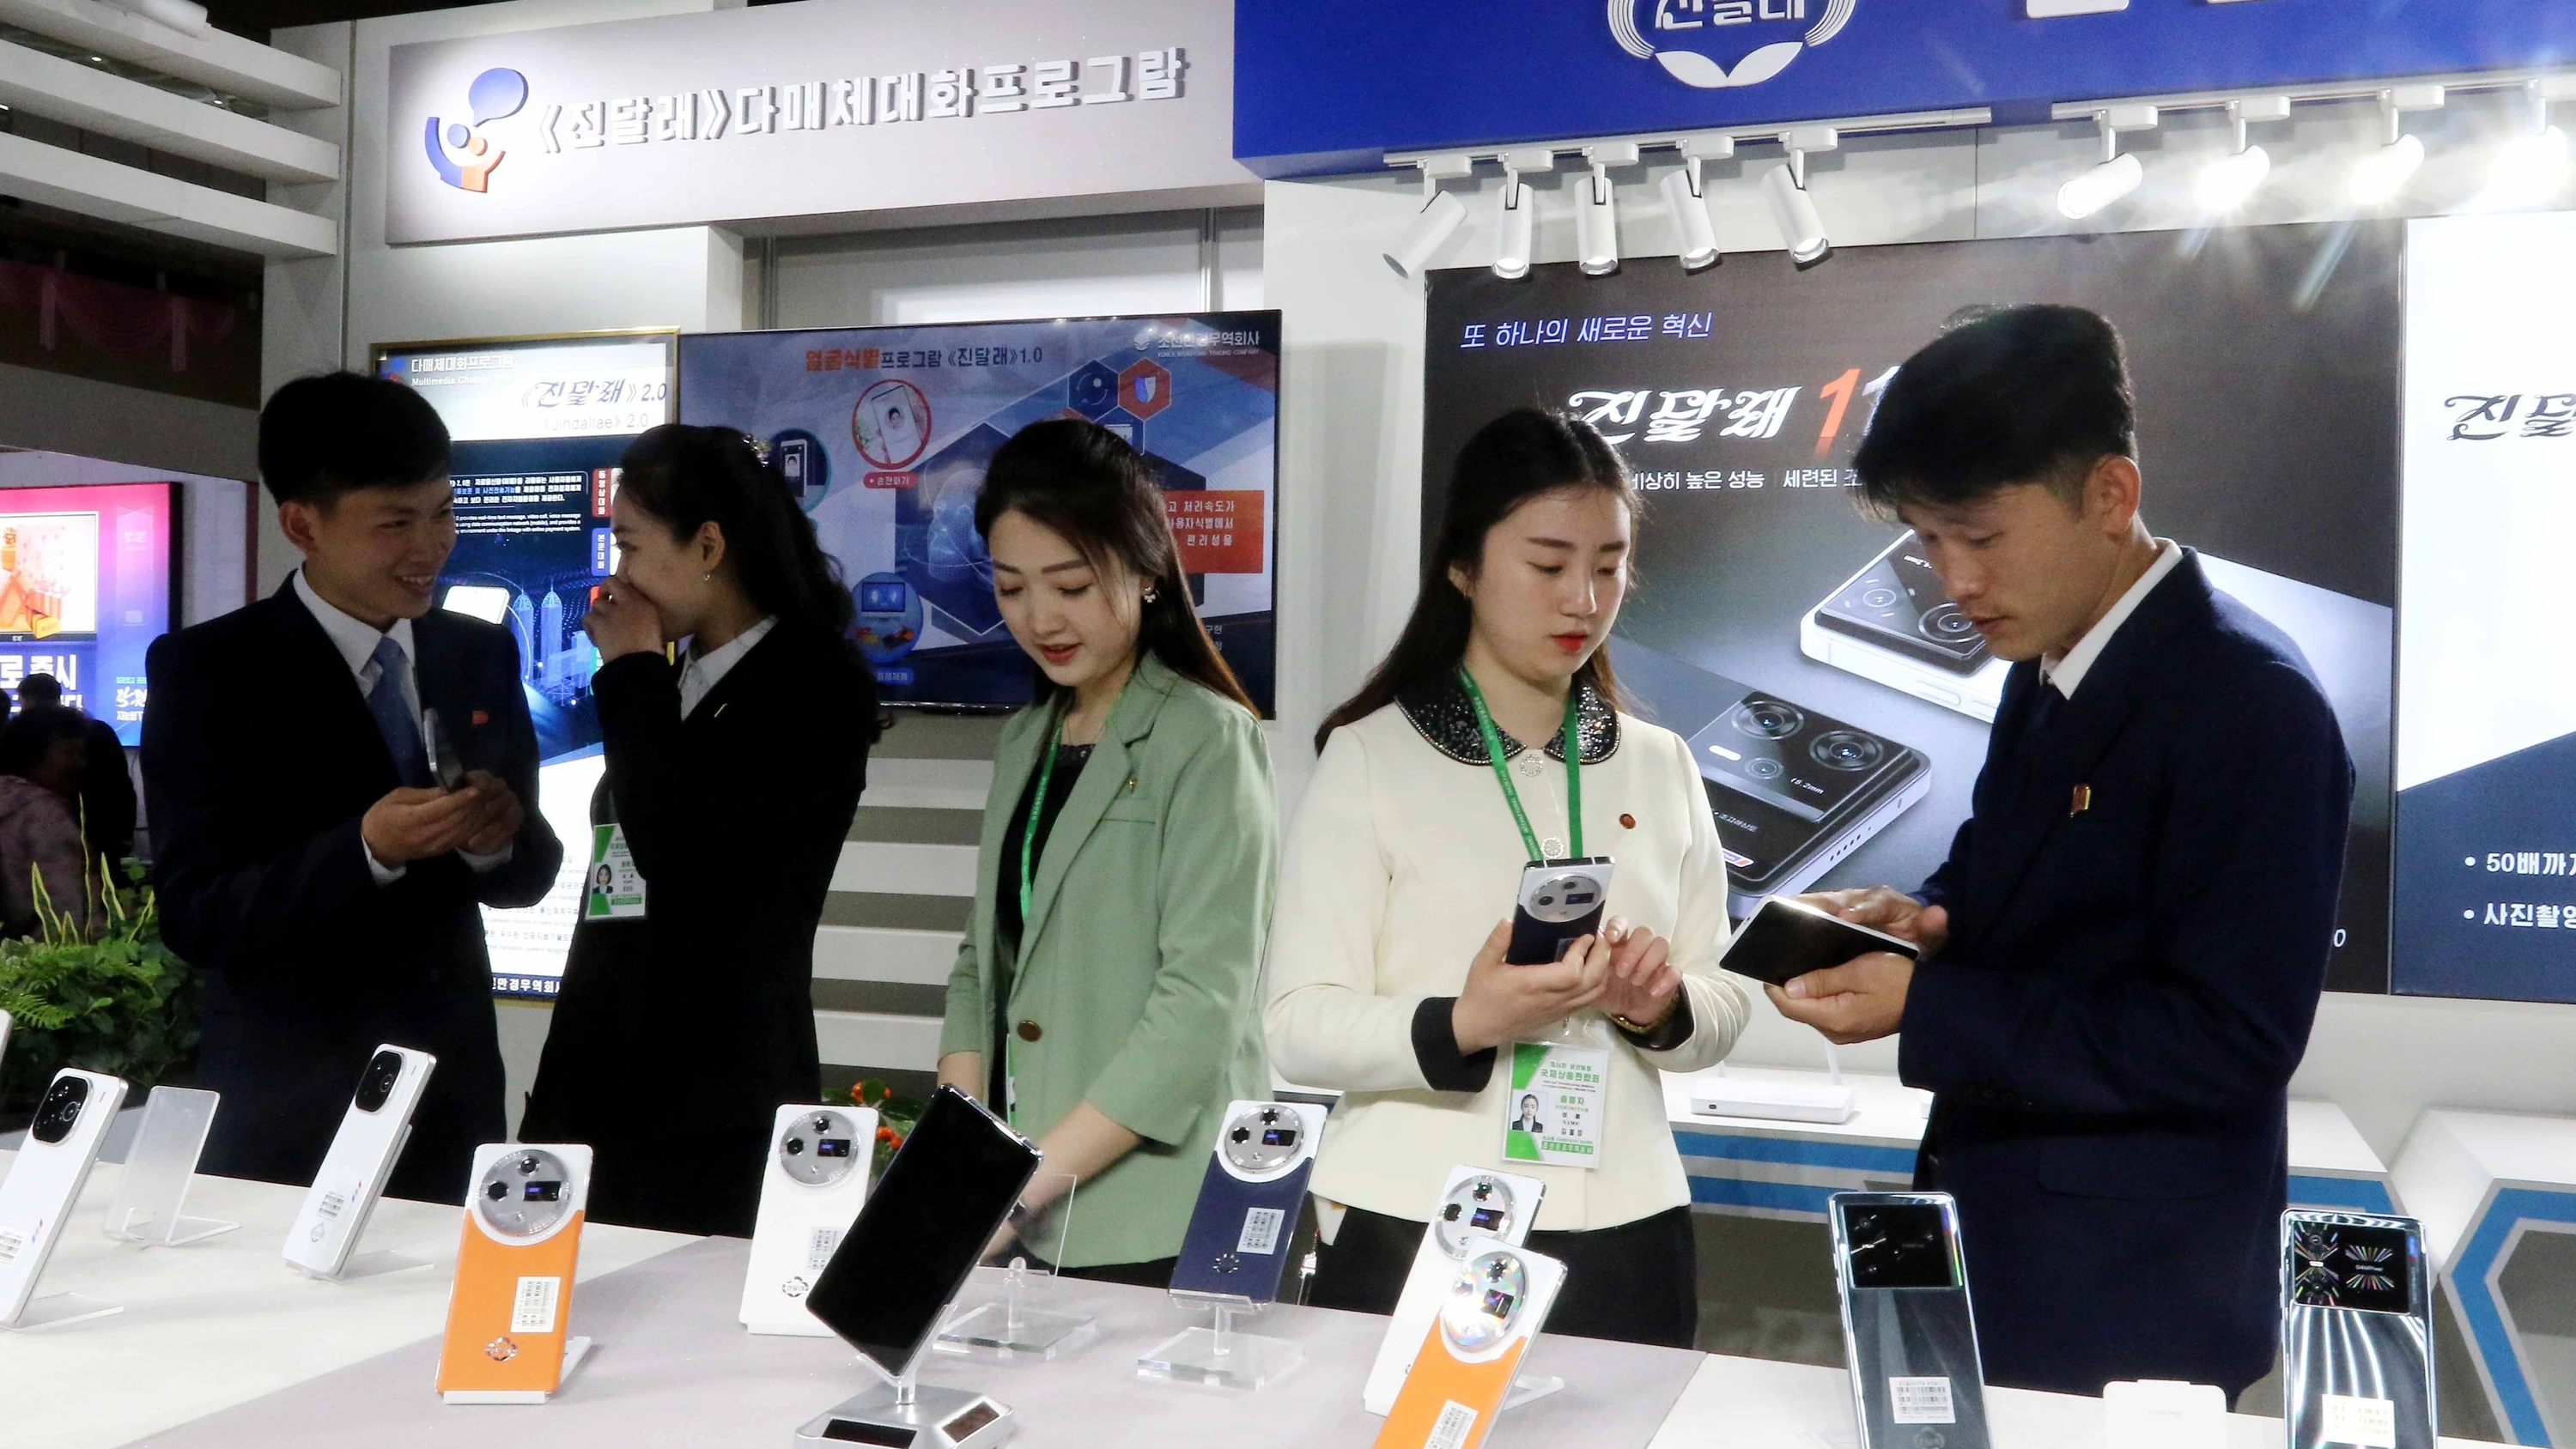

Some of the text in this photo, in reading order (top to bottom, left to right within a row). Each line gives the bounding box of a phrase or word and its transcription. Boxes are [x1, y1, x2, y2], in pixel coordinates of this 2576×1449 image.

[1461, 311, 1713, 349] 또 하나의 새로운 혁신
[411, 376, 455, 386] Multimedia
[627, 412, 648, 428] 2.0
[1686, 470, 1722, 489] 높은
[1728, 470, 1765, 489] 성능
[1783, 468, 1838, 488] 세련된
